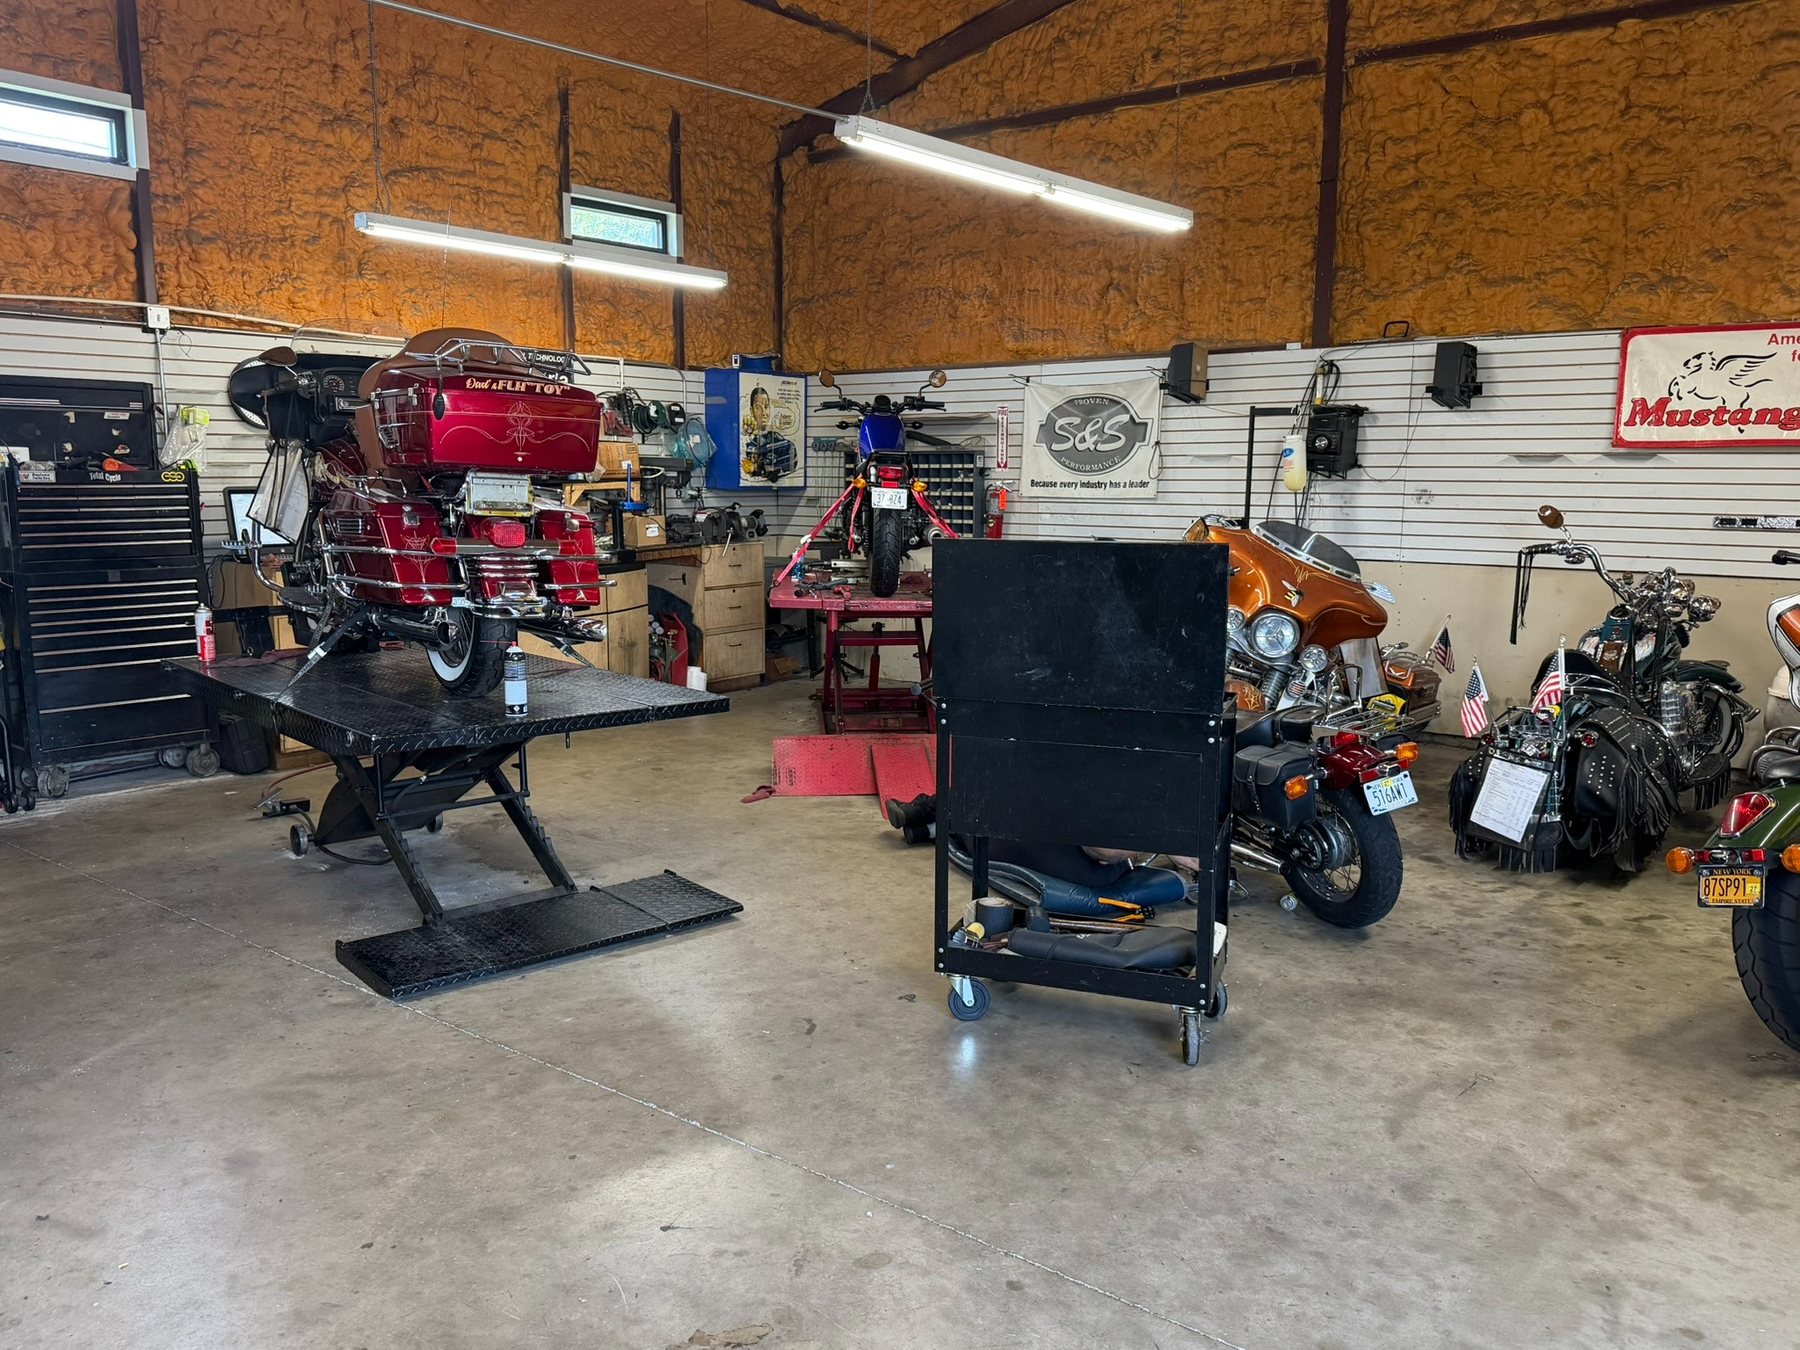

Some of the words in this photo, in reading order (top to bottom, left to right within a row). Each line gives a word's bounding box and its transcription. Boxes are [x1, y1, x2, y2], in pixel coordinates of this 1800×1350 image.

[1073, 397, 1110, 406] PROVEN
[1624, 396, 1800, 431] Mustang
[1050, 413, 1132, 452] S&S
[1060, 455, 1122, 472] PERFORMANCE
[1030, 479, 1058, 488] Because
[1059, 481, 1079, 490] every
[1080, 480, 1108, 491] industry
[1109, 480, 1121, 489] has
[1128, 480, 1150, 489] leader
[1703, 877, 1747, 897] 87SP91
